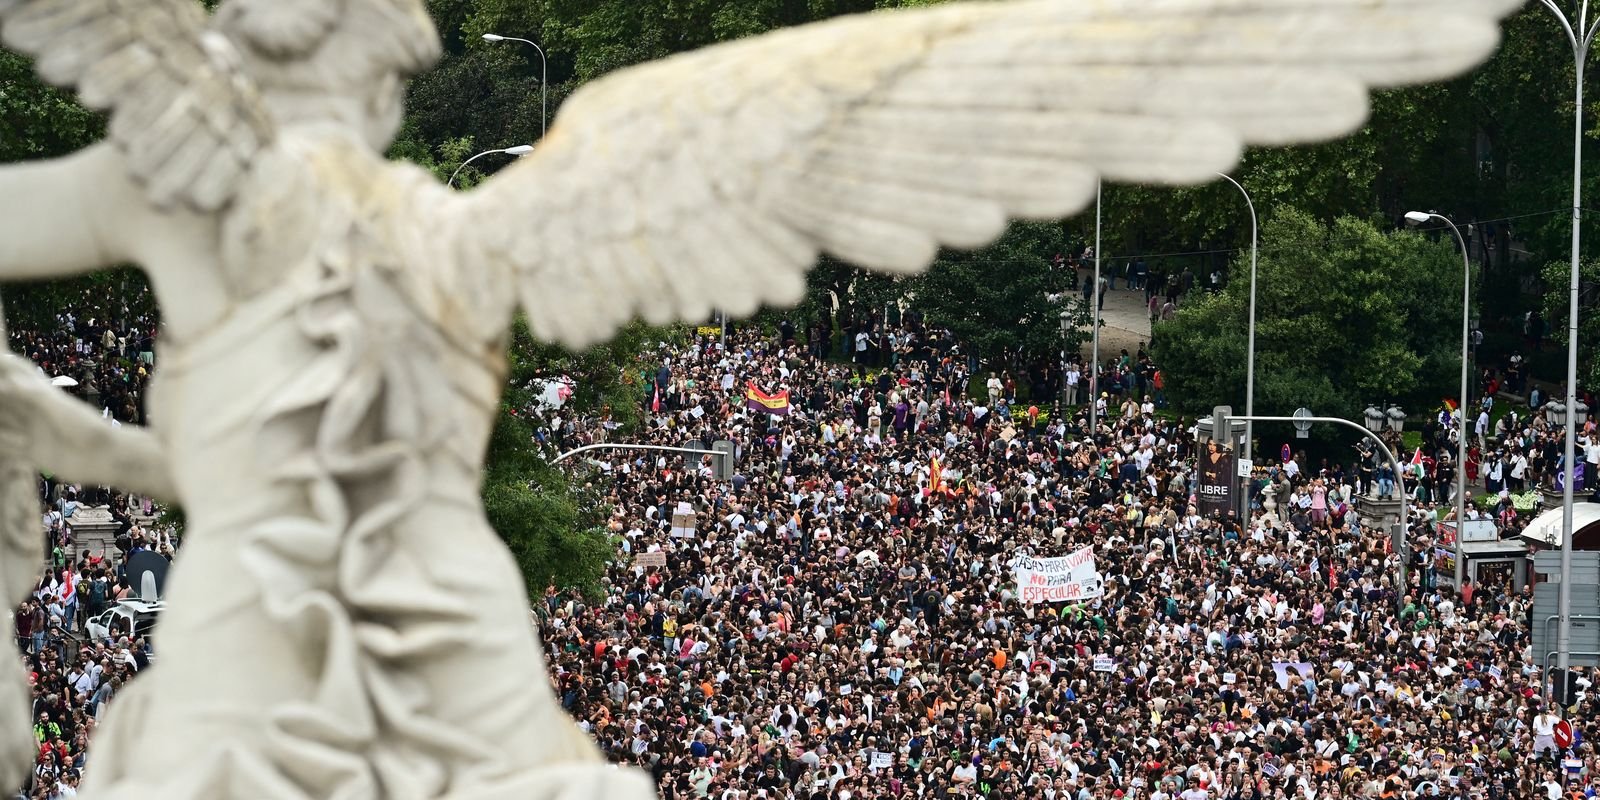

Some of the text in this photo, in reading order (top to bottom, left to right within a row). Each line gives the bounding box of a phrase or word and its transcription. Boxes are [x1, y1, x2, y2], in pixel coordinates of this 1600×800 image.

[1199, 484, 1228, 495] LIBRE
[1045, 559, 1071, 573] PARA
[1067, 547, 1093, 568] VIVIR
[1030, 574, 1047, 585] NO
[1047, 572, 1072, 586] PARA
[1023, 583, 1081, 600] ESPECULAR
